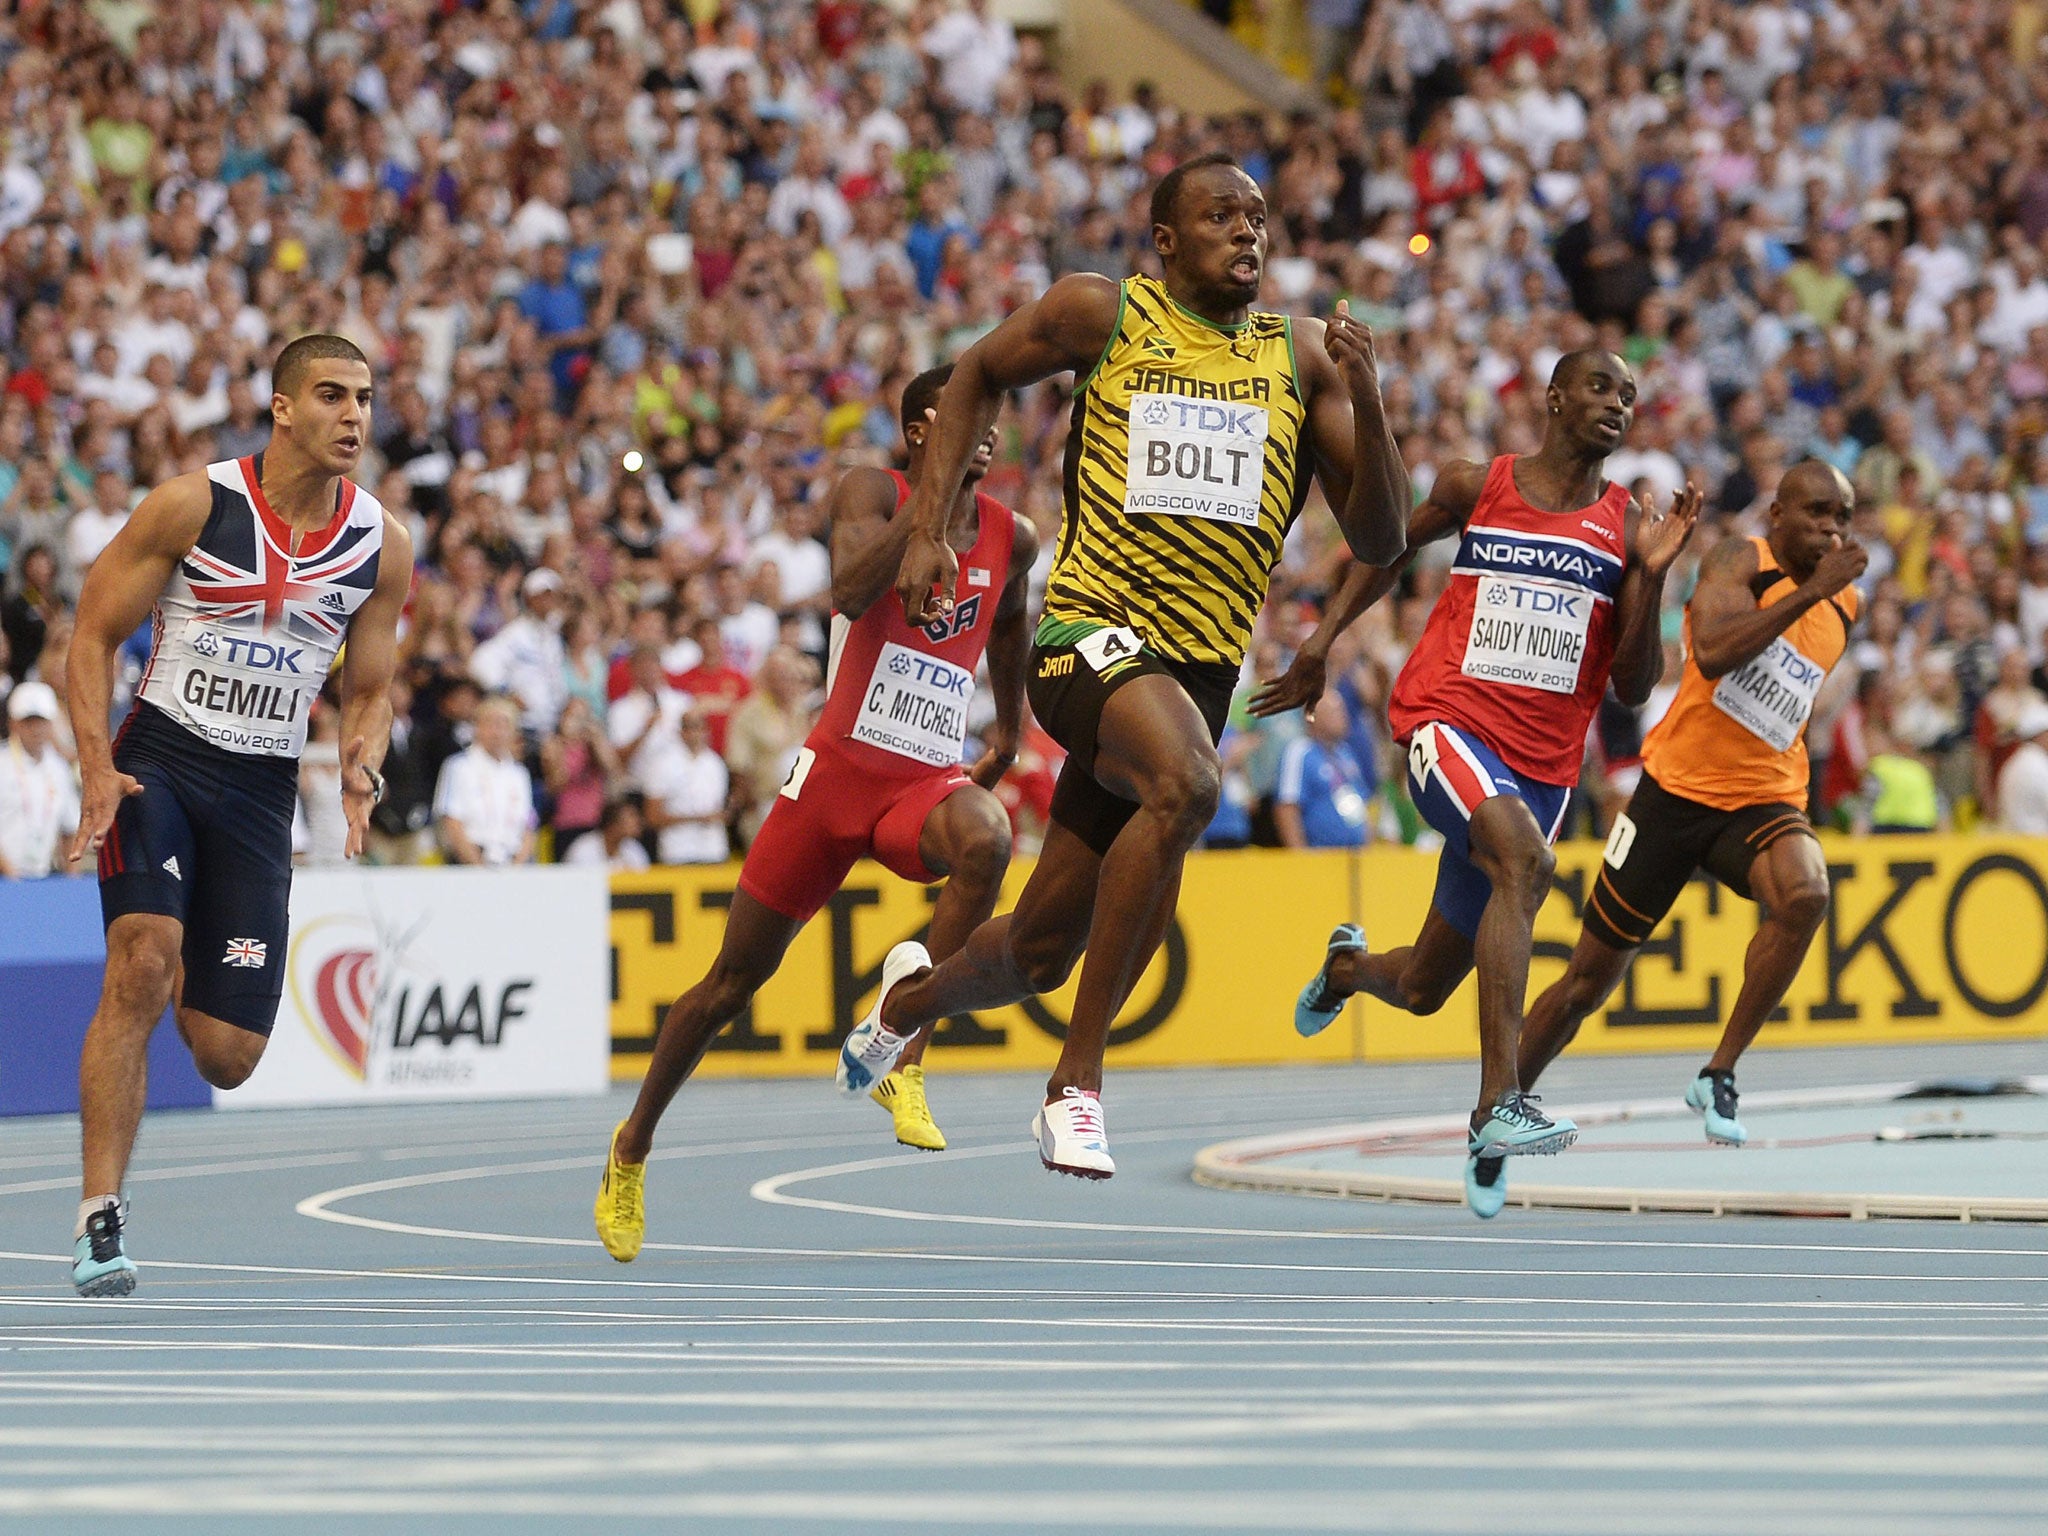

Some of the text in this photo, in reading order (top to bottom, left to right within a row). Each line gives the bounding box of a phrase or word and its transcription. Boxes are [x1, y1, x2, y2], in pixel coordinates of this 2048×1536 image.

[1123, 368, 1270, 402] JAMAICA
[1171, 401, 1256, 437] TDK
[1146, 440, 1249, 486] BOLT
[1129, 495, 1255, 521] MOSCOW 2013
[1472, 541, 1603, 579] NORWAY
[1509, 586, 1581, 618] TDK
[222, 636, 304, 674] TDK
[1103, 633, 1131, 657] 4
[1473, 617, 1582, 663] SAIDY NDURE
[914, 658, 967, 697] TDK
[1038, 653, 1075, 678] JAM
[1467, 663, 1574, 690] MOSCOW 2013
[1780, 646, 1820, 690] TDK
[183, 668, 300, 722] GEMILI
[868, 682, 962, 742] C. MITCHELL
[251, 735, 290, 751] 2013
[857, 725, 926, 755] MOSCOW
[1413, 742, 1428, 775] 2
[1612, 827, 1625, 855] 1
[393, 983, 533, 1047] IAAF
